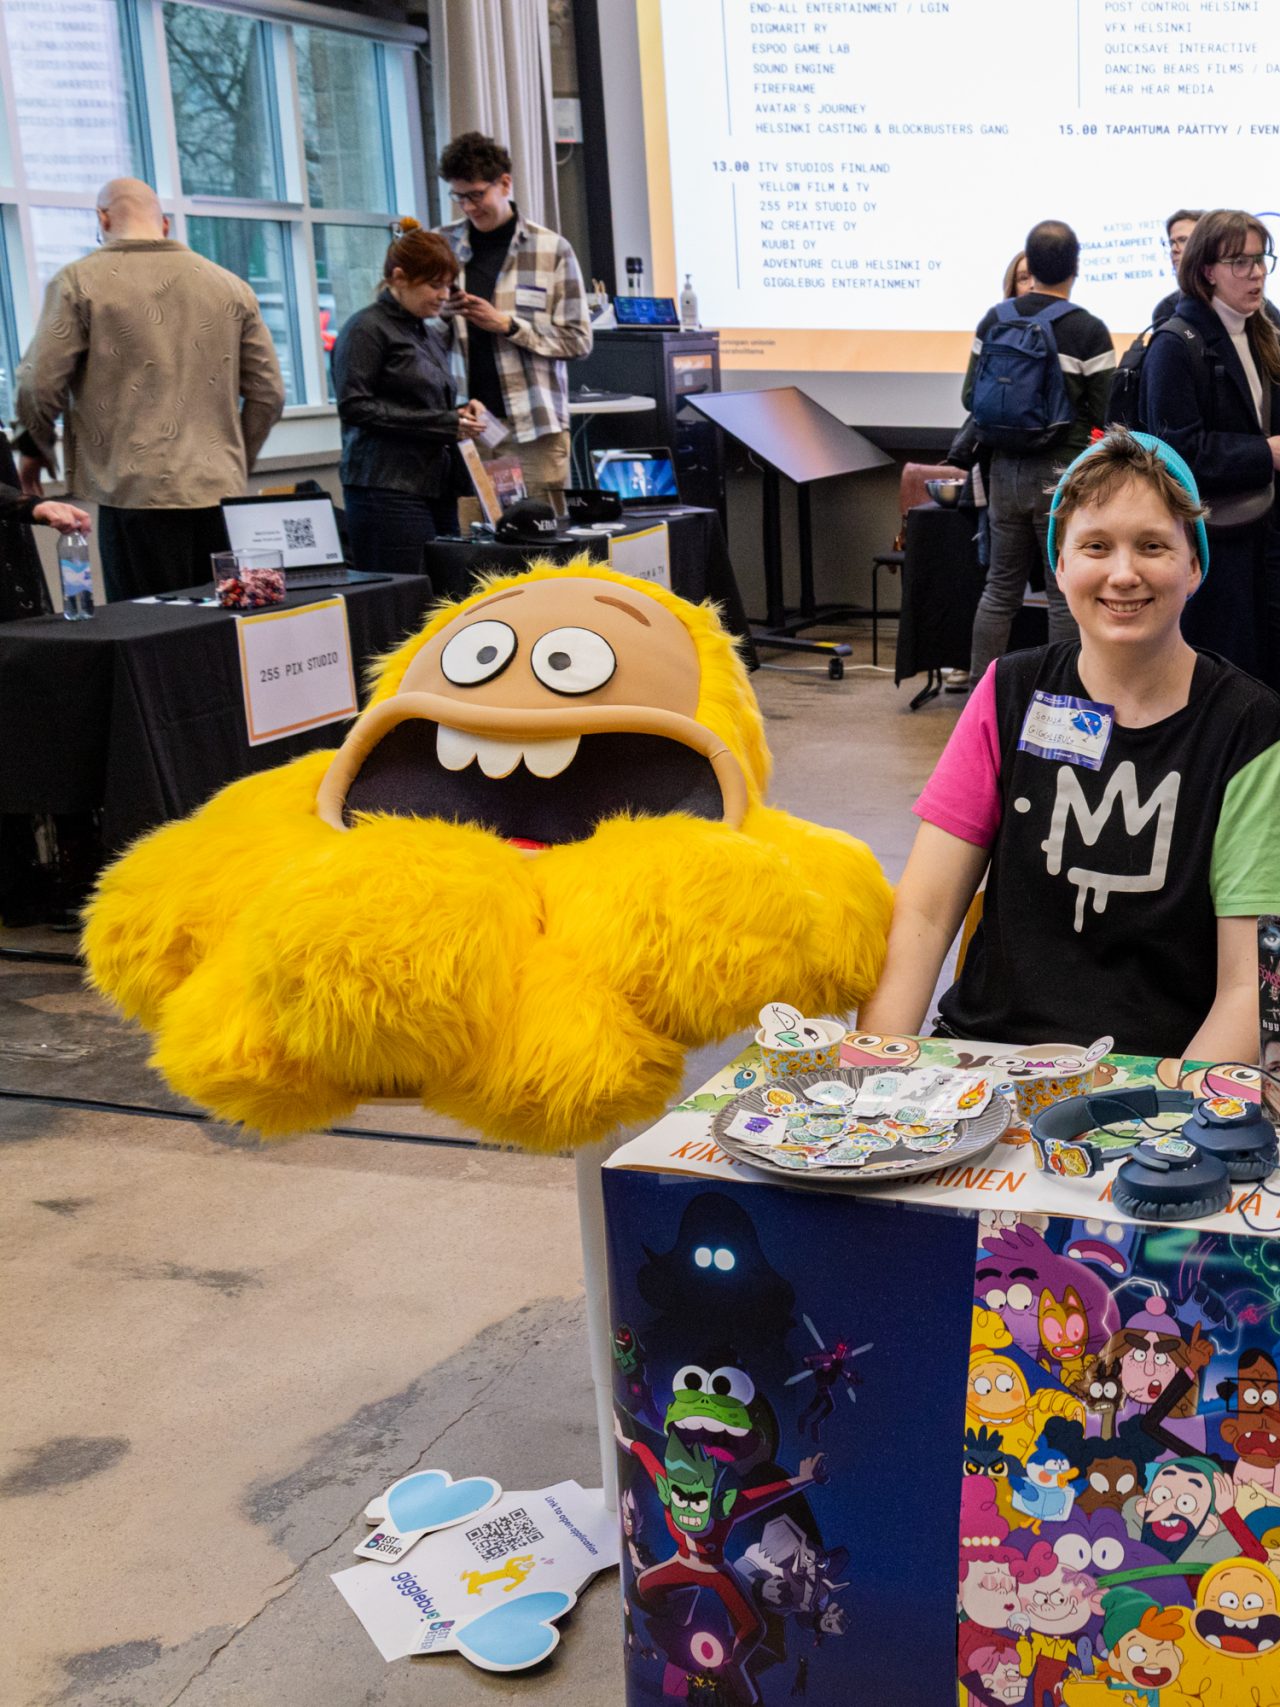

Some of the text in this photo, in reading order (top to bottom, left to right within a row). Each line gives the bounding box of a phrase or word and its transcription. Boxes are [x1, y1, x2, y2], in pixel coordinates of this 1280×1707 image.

[750, 3, 798, 13] END-ALL
[807, 3, 898, 13] ENTERTAINMENT
[1105, 2, 1259, 12] POST CONTROL HELSINKI
[751, 23, 828, 33] DIGMARIT RY
[1105, 23, 1192, 33] VFX HELSINKI
[752, 44, 850, 53] ESPOO GAME LAB
[1105, 43, 1258, 54] QUICKSAVE INTERACTIVE
[753, 64, 836, 74] SOUND ENGINE
[1105, 64, 1156, 74] DANCING
[1163, 64, 1200, 74] BEARS
[1207, 64, 1244, 74] FILMS
[754, 83, 815, 94] FIREFRAME
[1105, 85, 1214, 94] HEAR HEAR MEDIA
[818, 104, 866, 114] JOURNEY
[755, 123, 811, 134] HELSINKI
[818, 124, 867, 134] CASTING
[888, 124, 973, 135] BLOCKBUSTERS
[980, 125, 1009, 135] GANG
[1059, 125, 1098, 135] 15.00
[1106, 125, 1170, 135] TAPAHTUMA
[712, 161, 890, 173] 13.00 ITV STUDIOS FINLAND
[759, 182, 800, 192] YELLOW
[807, 182, 835, 192] FILM
[856, 182, 870, 192] TV
[760, 201, 877, 212] 255 PIX STUDIO OY
[761, 220, 857, 231] N2 CREATIVE OY
[761, 240, 816, 250] KUUBI OY
[763, 259, 942, 271] ADVENTURE CLUB HELSINKI OY
[763, 278, 921, 289] GIGGLEBUG ENTERTAINMENT
[260, 652, 338, 682] 255 PIX STUDIO
[545, 1496, 598, 1555] Link to open application
[391, 1571, 440, 1622] gigglebug
